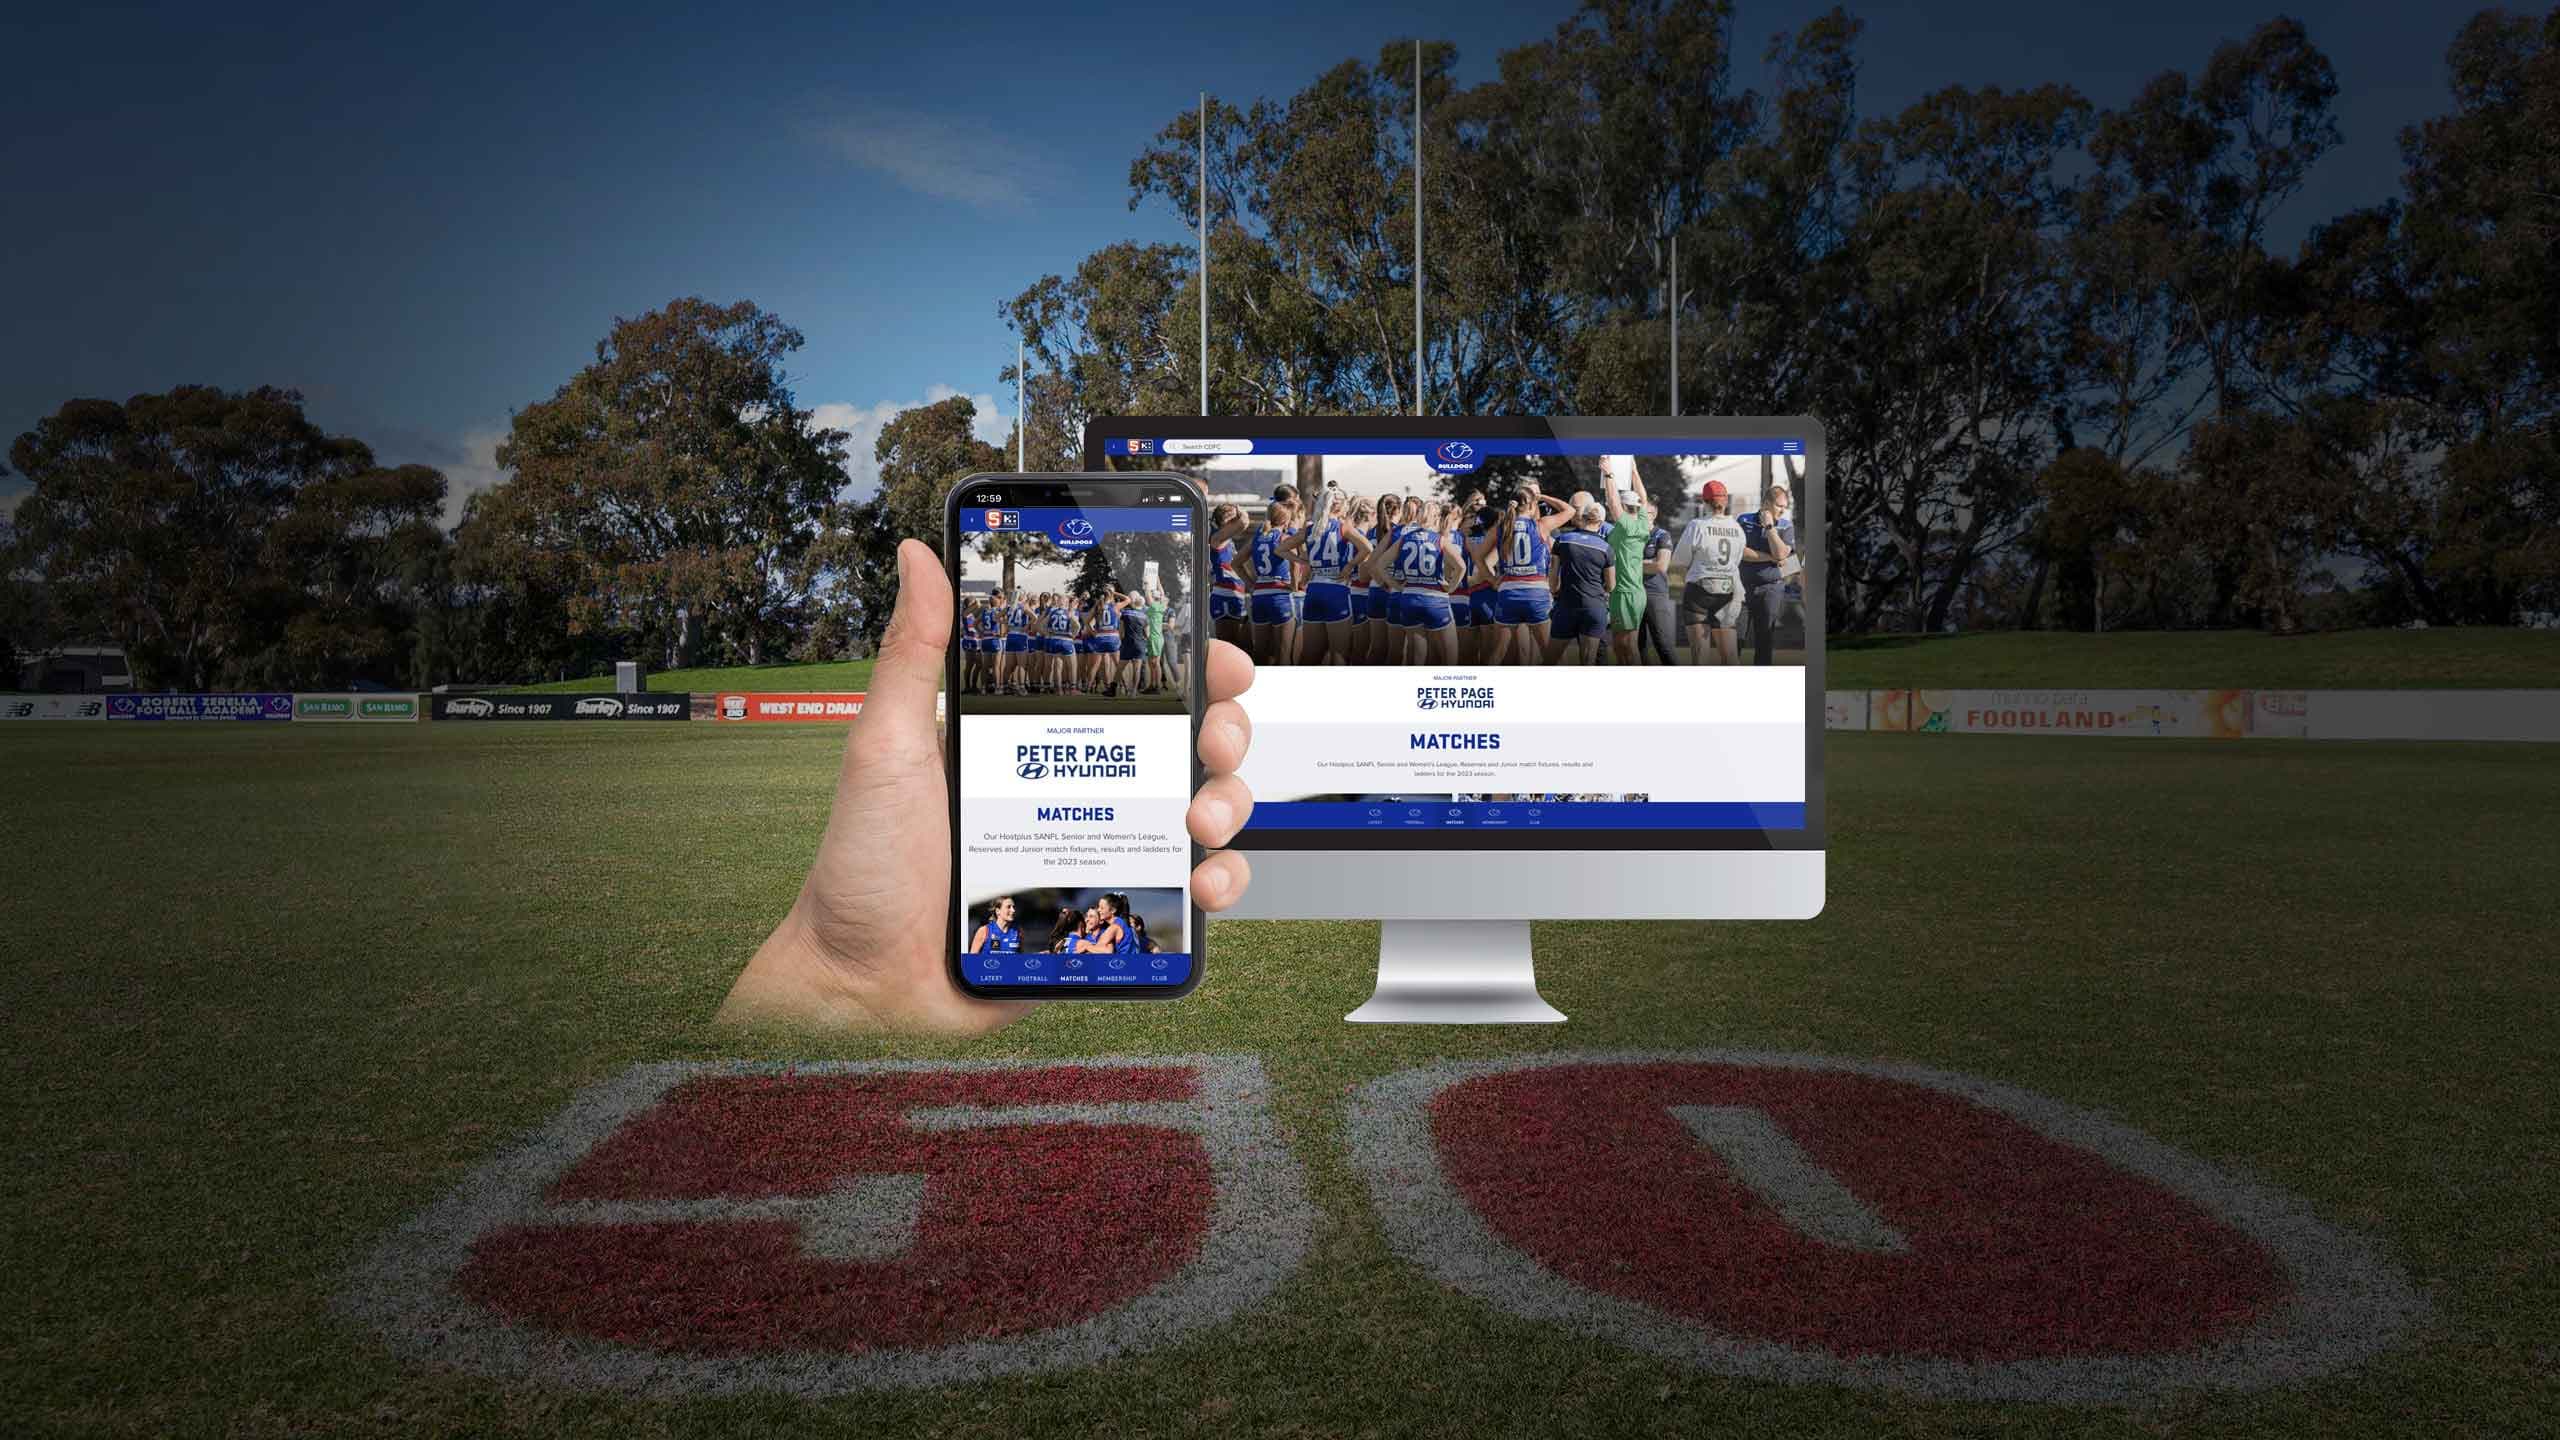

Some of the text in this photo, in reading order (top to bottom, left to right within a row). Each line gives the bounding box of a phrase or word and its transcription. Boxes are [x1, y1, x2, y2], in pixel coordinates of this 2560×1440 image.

[976, 495, 1002, 503] 12:59
[988, 511, 1000, 527] S
[1706, 526, 1740, 537] TRAINER
[1309, 531, 1340, 567] 24
[1514, 532, 1532, 565] 0
[1718, 538, 1731, 566] 9
[1257, 544, 1273, 575] 3
[1402, 541, 1437, 576] 26
[1008, 611, 1023, 626] 24
[1051, 615, 1067, 631] 26
[1417, 687, 1495, 699] PETER PAGE
[142, 697, 258, 706] ROBERT ZERELLA
[303, 703, 320, 712] SAN
[366, 703, 383, 712] SAN
[445, 700, 552, 717] Burley Since 1907
[575, 700, 680, 717] Burley Since 1907
[759, 702, 864, 714] WEST END DRAU
[1441, 700, 1495, 709] HYUNDAI
[137, 706, 263, 715] FOOTBALL ACADEMY
[1967, 710, 2115, 728] FOODLAND
[1410, 733, 1501, 750] MATCHES
[1016, 745, 1136, 762] PETER PAGE
[1054, 764, 1136, 777] HYUNDAI
[1037, 807, 1115, 821] MATCHES
[984, 833, 998, 841] Our
[999, 833, 1032, 842] Hostplus
[1033, 833, 1059, 841] SANFL
[1061, 833, 1085, 841] Senior
[1086, 833, 1101, 841] and
[1103, 833, 1137, 841] Women's
[968, 846, 1003, 854] Reserves
[1004, 846, 1018, 854] and
[1020, 846, 1043, 854] Junior
[1045, 846, 1068, 854] match
[1100, 846, 1125, 854] results
[1126, 846, 1141, 854] and
[1142, 846, 1170, 854] ladders
[1172, 846, 1183, 854] for
[1043, 858, 1056, 866] the
[1057, 858, 1077, 866] 2023
[335, 1052, 2440, 1402] 50
